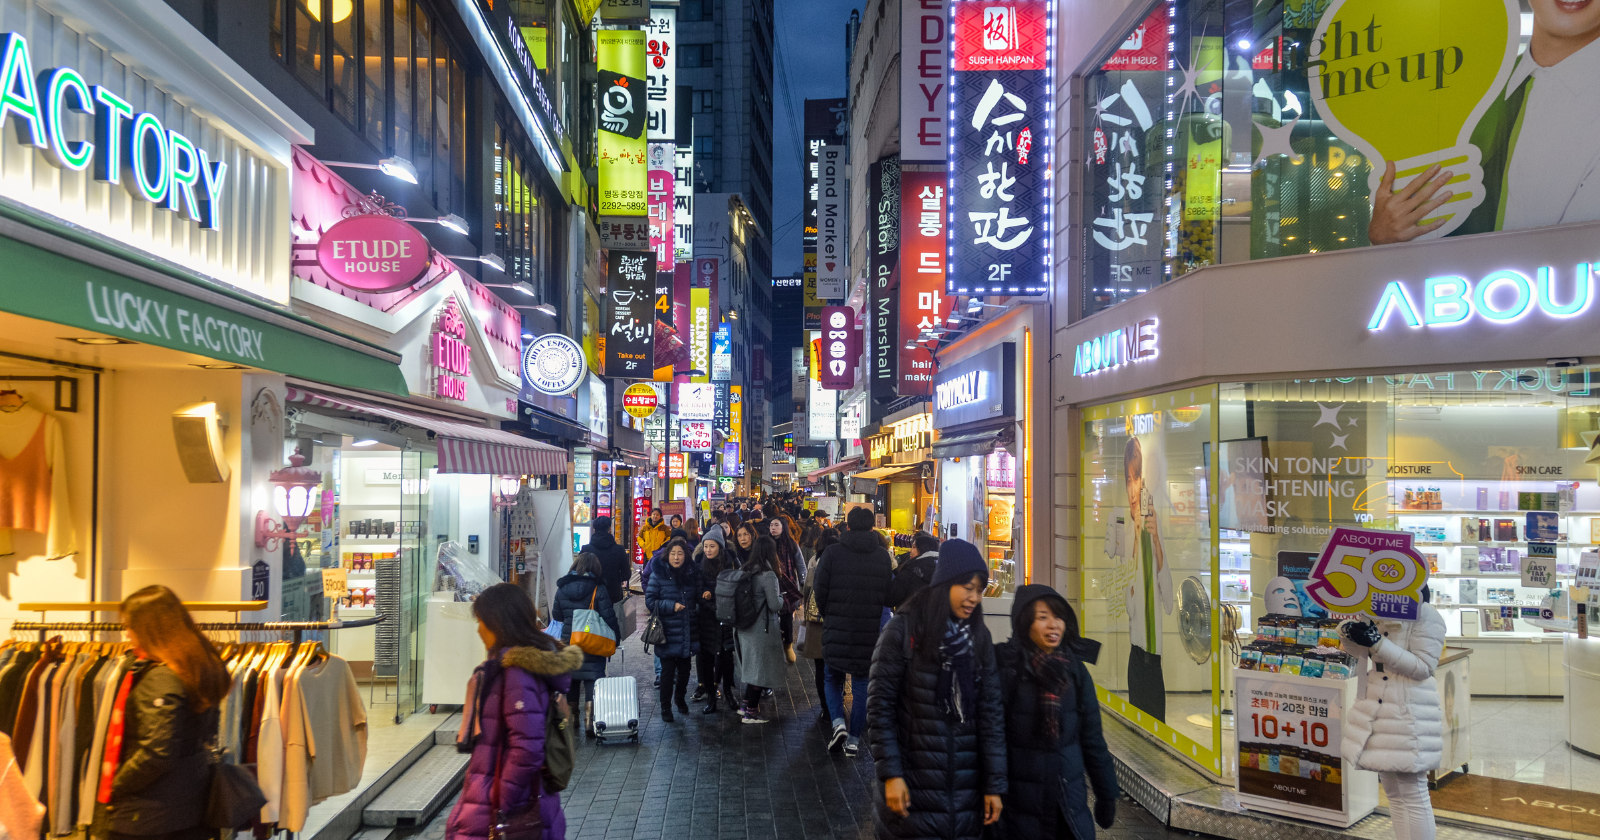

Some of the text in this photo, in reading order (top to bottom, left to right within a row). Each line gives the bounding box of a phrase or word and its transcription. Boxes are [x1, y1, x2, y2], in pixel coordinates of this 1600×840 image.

[646, 18, 670, 34] 수원
[968, 56, 1035, 64] SUSHI HANPAN
[508, 15, 532, 79] KOREAN
[552, 113, 564, 146] CAFE
[1318, 45, 1464, 100] me up
[0, 32, 227, 231] ACTORY
[604, 190, 644, 199] 명동중앙점
[601, 202, 646, 210] 2292-5892
[824, 150, 838, 260] Brand Market
[918, 186, 944, 237] 샬롱
[647, 178, 668, 262] 부대찌개
[610, 224, 648, 241] 부동산
[332, 239, 412, 259] ETUDE
[344, 261, 400, 272] HOUSE
[917, 252, 942, 274] 드
[988, 264, 1012, 281] 2F
[878, 200, 891, 378] Salon de Marshall
[1367, 262, 1600, 331] ABOU
[86, 281, 172, 340] LUCKY
[177, 308, 265, 362] FACTORY
[436, 331, 472, 378] ETUDE
[1073, 318, 1159, 377] ABOUT ME
[626, 361, 638, 370] 2F
[912, 360, 932, 368] hair
[437, 374, 468, 401] HOUSE
[538, 377, 566, 388] COFFEE
[625, 396, 656, 405] 수원왕갈비
[714, 390, 724, 418] 돈까스
[1235, 457, 1374, 475] SKIN TONE UP
[1387, 466, 1432, 474] MOISTURE
[1516, 466, 1562, 474] SKIN CARE
[1235, 480, 1355, 498] LIGHTENING
[1235, 501, 1291, 518] MASK
[1235, 523, 1331, 535] Brightening solution
[1340, 534, 1404, 548] ABOUT ME
[1282, 564, 1311, 574] Hyaluronic
[254, 581, 264, 598] 20
[1370, 592, 1410, 605] BRAND
[1370, 602, 1408, 614] SALE
[1251, 698, 1328, 718] 초특가 20장 만원
[1252, 713, 1328, 748] 10+10
[1273, 784, 1307, 796] ABOUT ME
